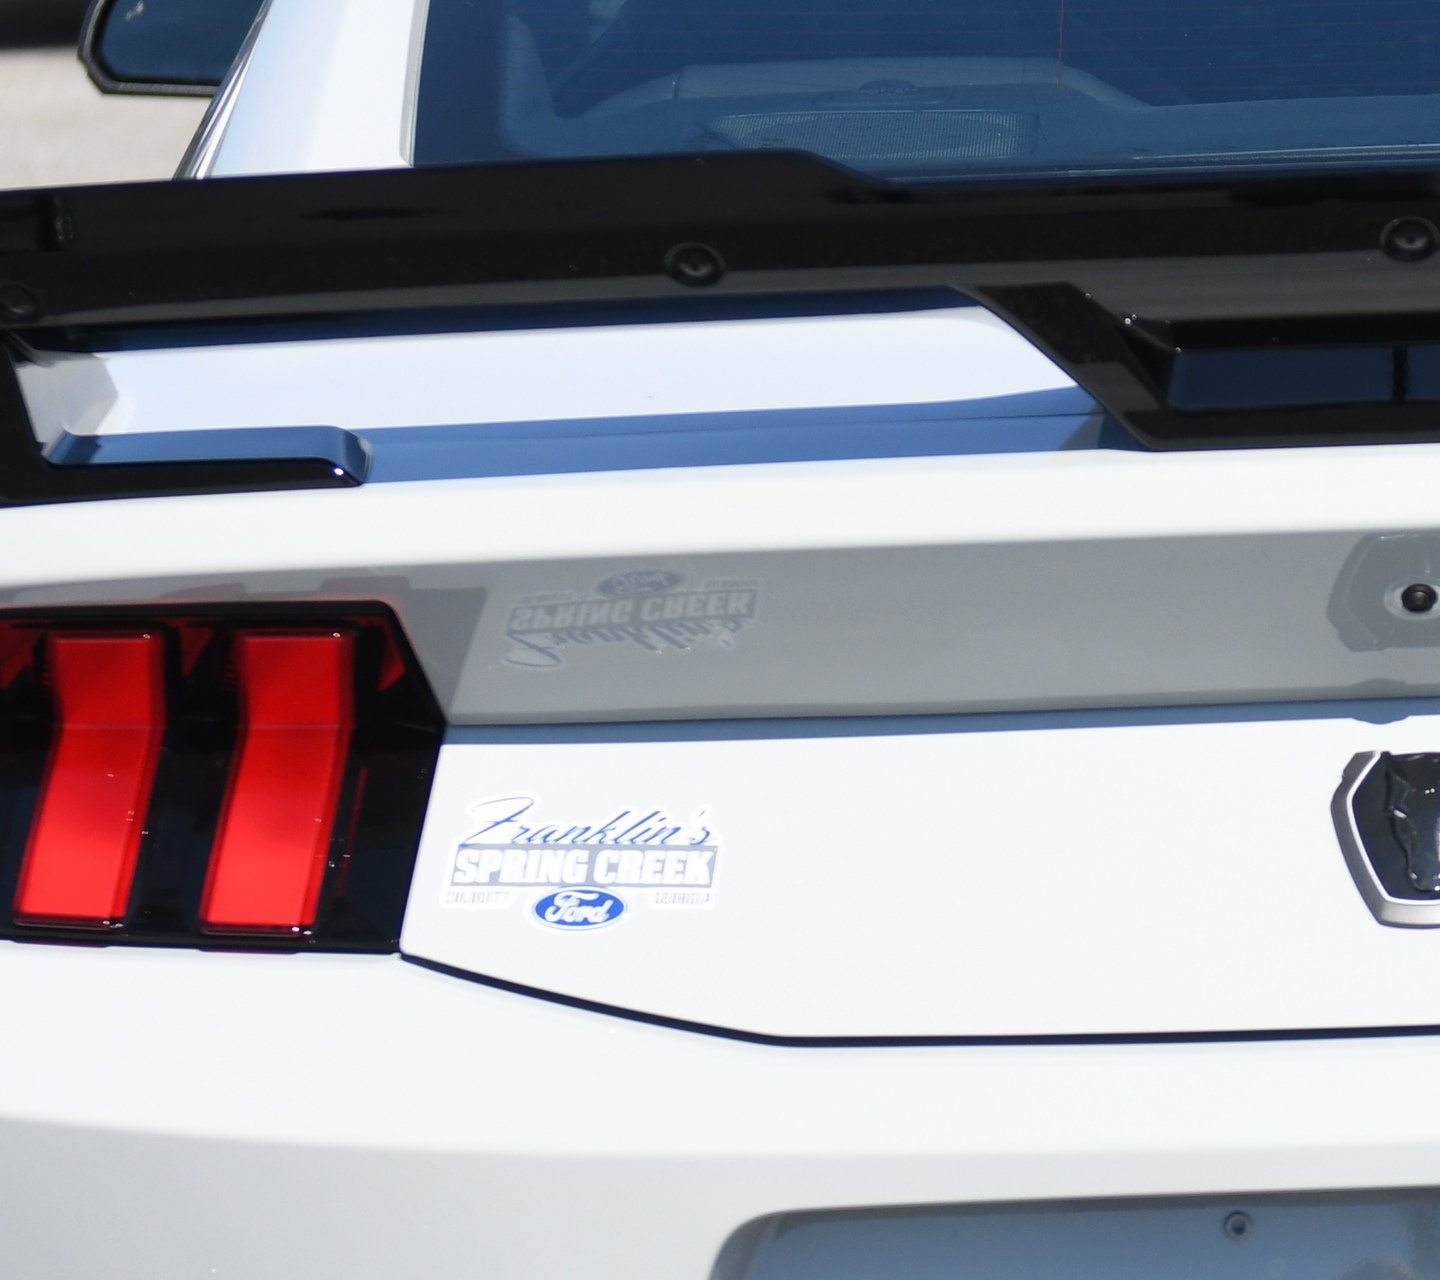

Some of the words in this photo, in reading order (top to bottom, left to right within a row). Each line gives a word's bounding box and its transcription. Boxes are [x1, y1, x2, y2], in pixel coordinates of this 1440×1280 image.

[460, 797, 710, 847] Franklin's
[453, 849, 590, 884] SPRING
[593, 850, 714, 885] CREEK
[545, 891, 614, 923] Ford
